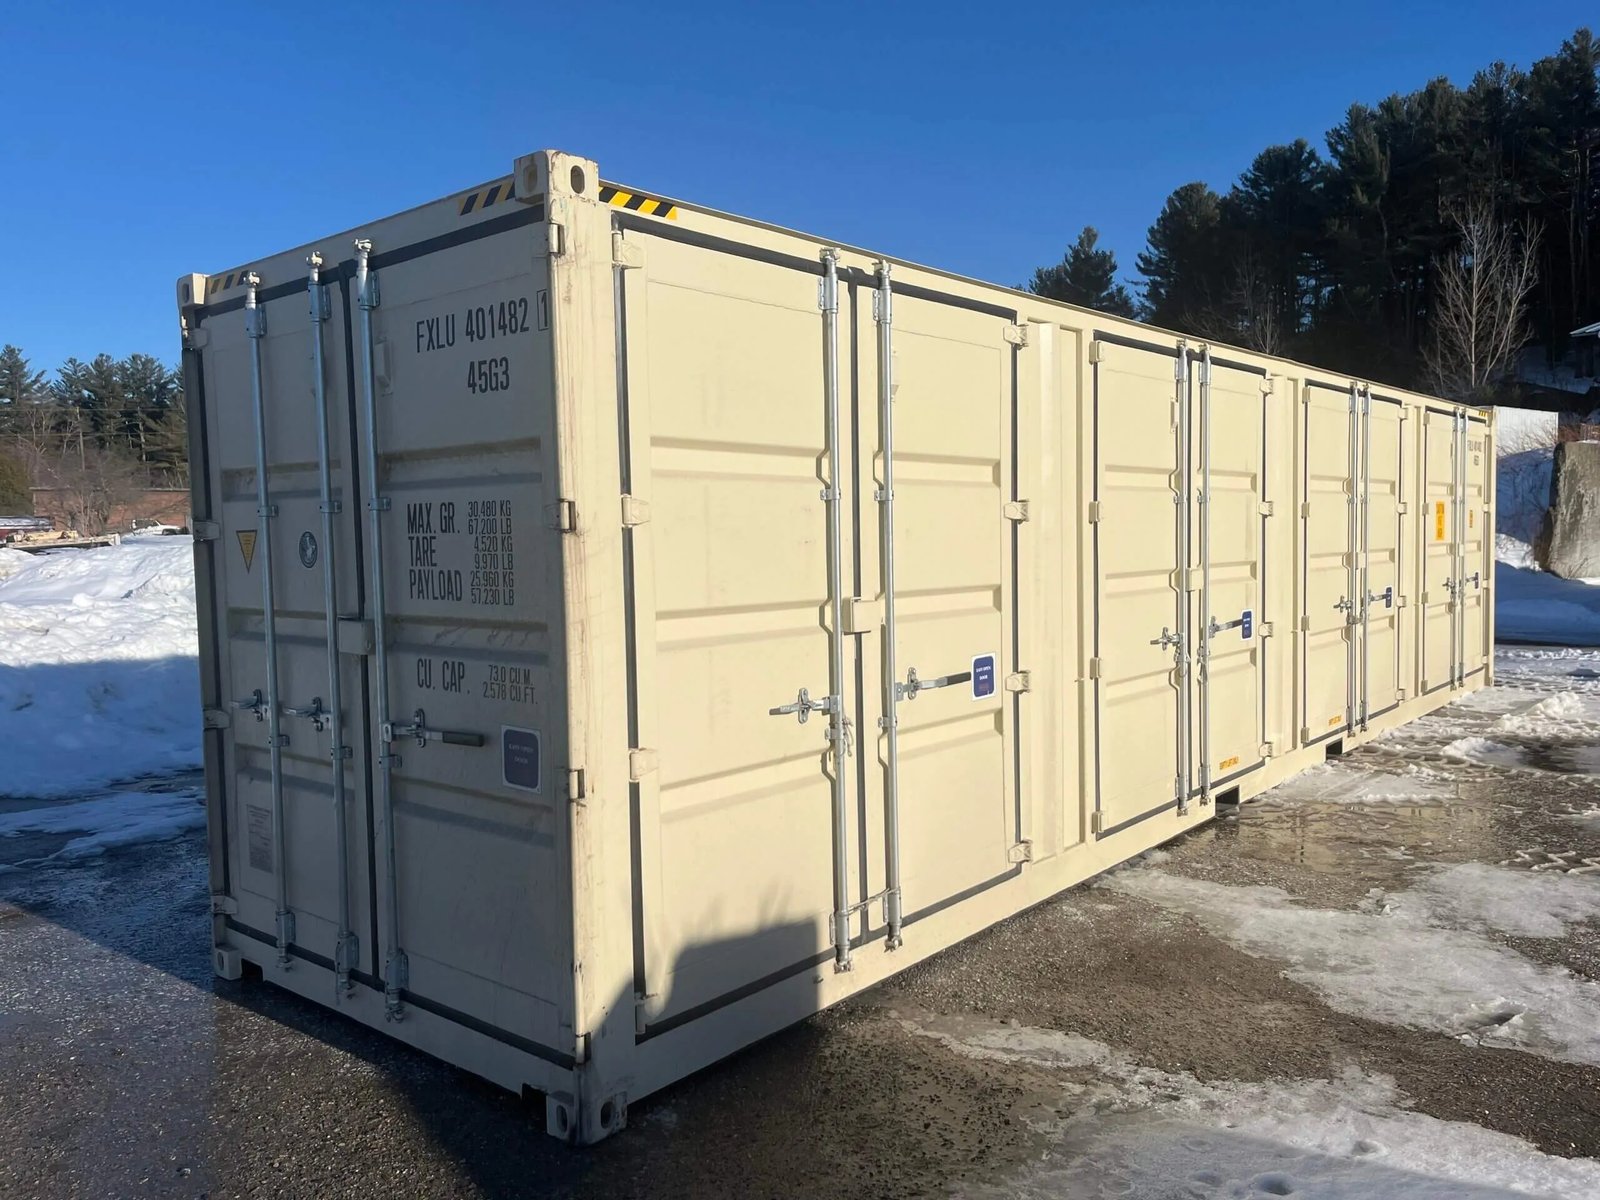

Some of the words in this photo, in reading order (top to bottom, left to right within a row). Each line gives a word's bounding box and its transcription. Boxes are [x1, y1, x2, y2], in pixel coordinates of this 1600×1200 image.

[416, 313, 455, 353] FXLU
[465, 297, 530, 343] 401482
[541, 292, 548, 328] 1
[467, 356, 510, 394] 45G3
[407, 502, 436, 534] MAX.
[440, 502, 460, 534] GR.
[500, 500, 511, 517] KG
[500, 518, 512, 535] LB
[408, 536, 437, 567] TARE
[501, 536, 513, 553] KG
[502, 553, 513, 570] LB
[409, 569, 462, 602] PAYLOAD
[502, 571, 514, 588] KG
[503, 589, 514, 606] LB
[417, 658, 435, 690] CU.
[442, 660, 470, 695] CAP.
[488, 664, 506, 683] 73.0
